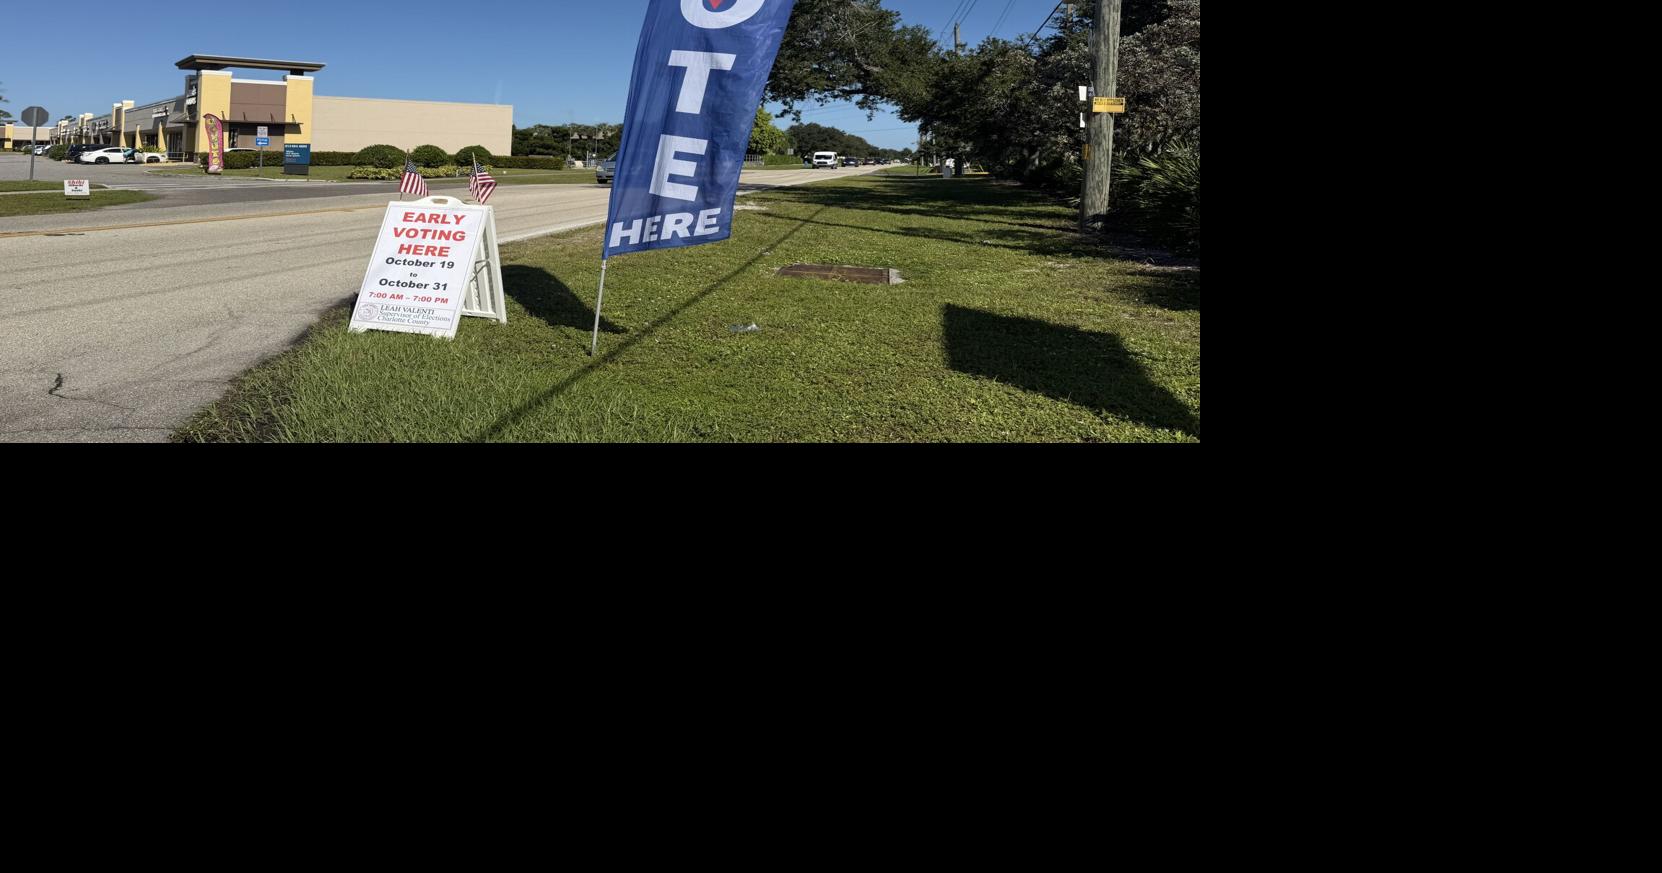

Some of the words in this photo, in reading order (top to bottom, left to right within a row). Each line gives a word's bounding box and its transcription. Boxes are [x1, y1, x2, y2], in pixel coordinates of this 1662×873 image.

[402, 211, 466, 225] EARLY
[608, 207, 721, 248] HERE
[393, 227, 466, 242] VOTING
[397, 243, 451, 258] HERE
[385, 257, 436, 268] October
[439, 260, 455, 269] 19
[378, 278, 430, 290] October
[432, 282, 448, 291] 31
[368, 291, 387, 299] 7:00
[389, 292, 404, 300] AM
[412, 295, 432, 303] 7:00
[380, 304, 401, 312] LEAH
[402, 306, 435, 315] VALENTI
[377, 315, 406, 323] Charlotte
[379, 310, 412, 319] Supervisor
[421, 314, 451, 322] Elections
